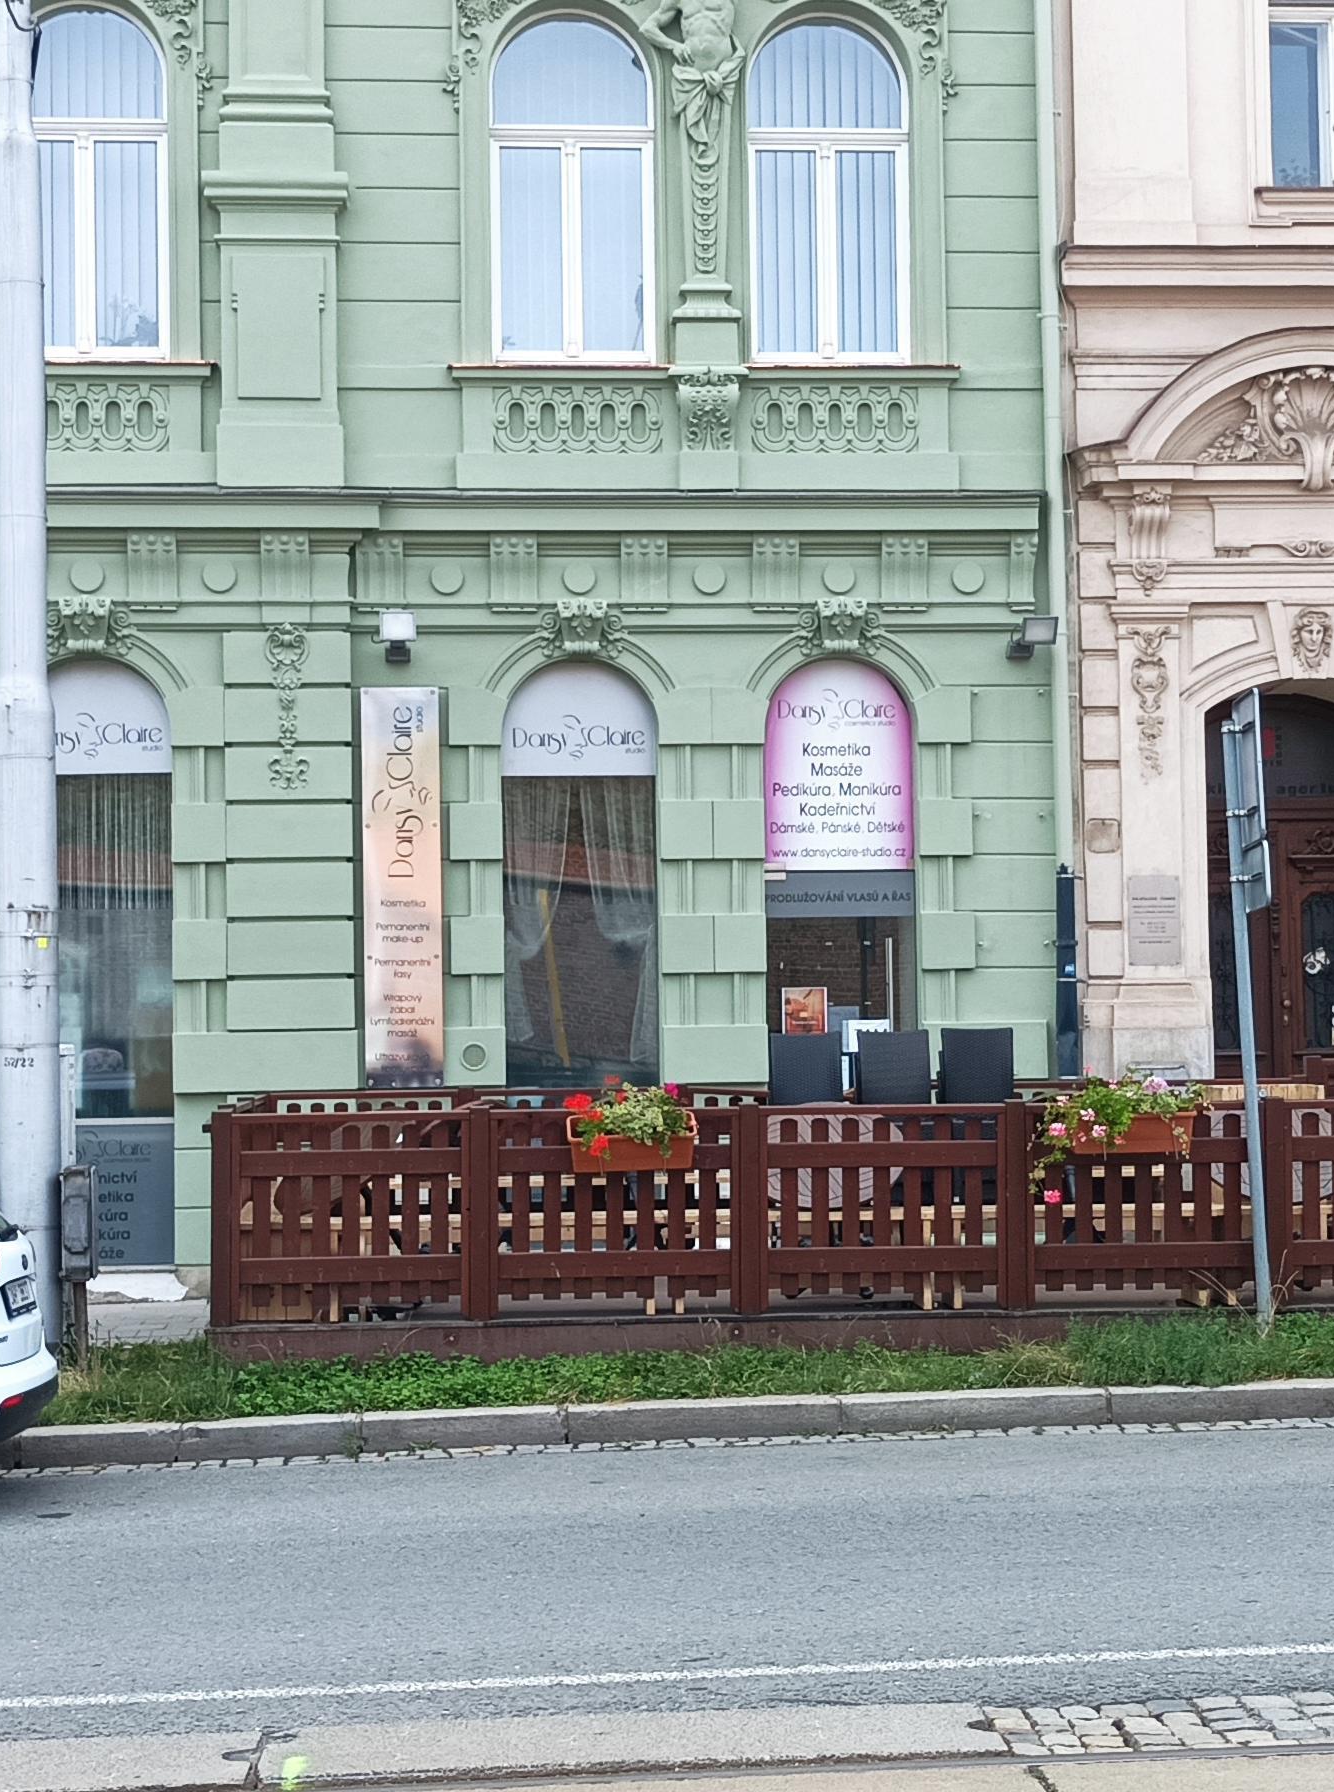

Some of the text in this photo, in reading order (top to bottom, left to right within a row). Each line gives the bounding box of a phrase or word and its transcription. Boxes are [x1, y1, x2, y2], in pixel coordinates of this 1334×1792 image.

[844, 699, 896, 719] Claire
[102, 723, 163, 744] Claire
[587, 725, 645, 746] Claire
[386, 706, 413, 781] Claire
[802, 742, 871, 757] Kosmetika
[810, 762, 863, 777] Masáže
[772, 781, 902, 797] Pedikúra, Manikúra
[799, 801, 876, 816] Kadeřnictví
[770, 821, 906, 835] Dámské, Pánské, Dětské
[772, 847, 907, 859] www.dansyclaire-studio.cz
[847, 889, 879, 902] VLASŮ
[880, 892, 890, 901] A
[891, 889, 911, 901] ŘAS
[98, 1191, 135, 1203] etika
